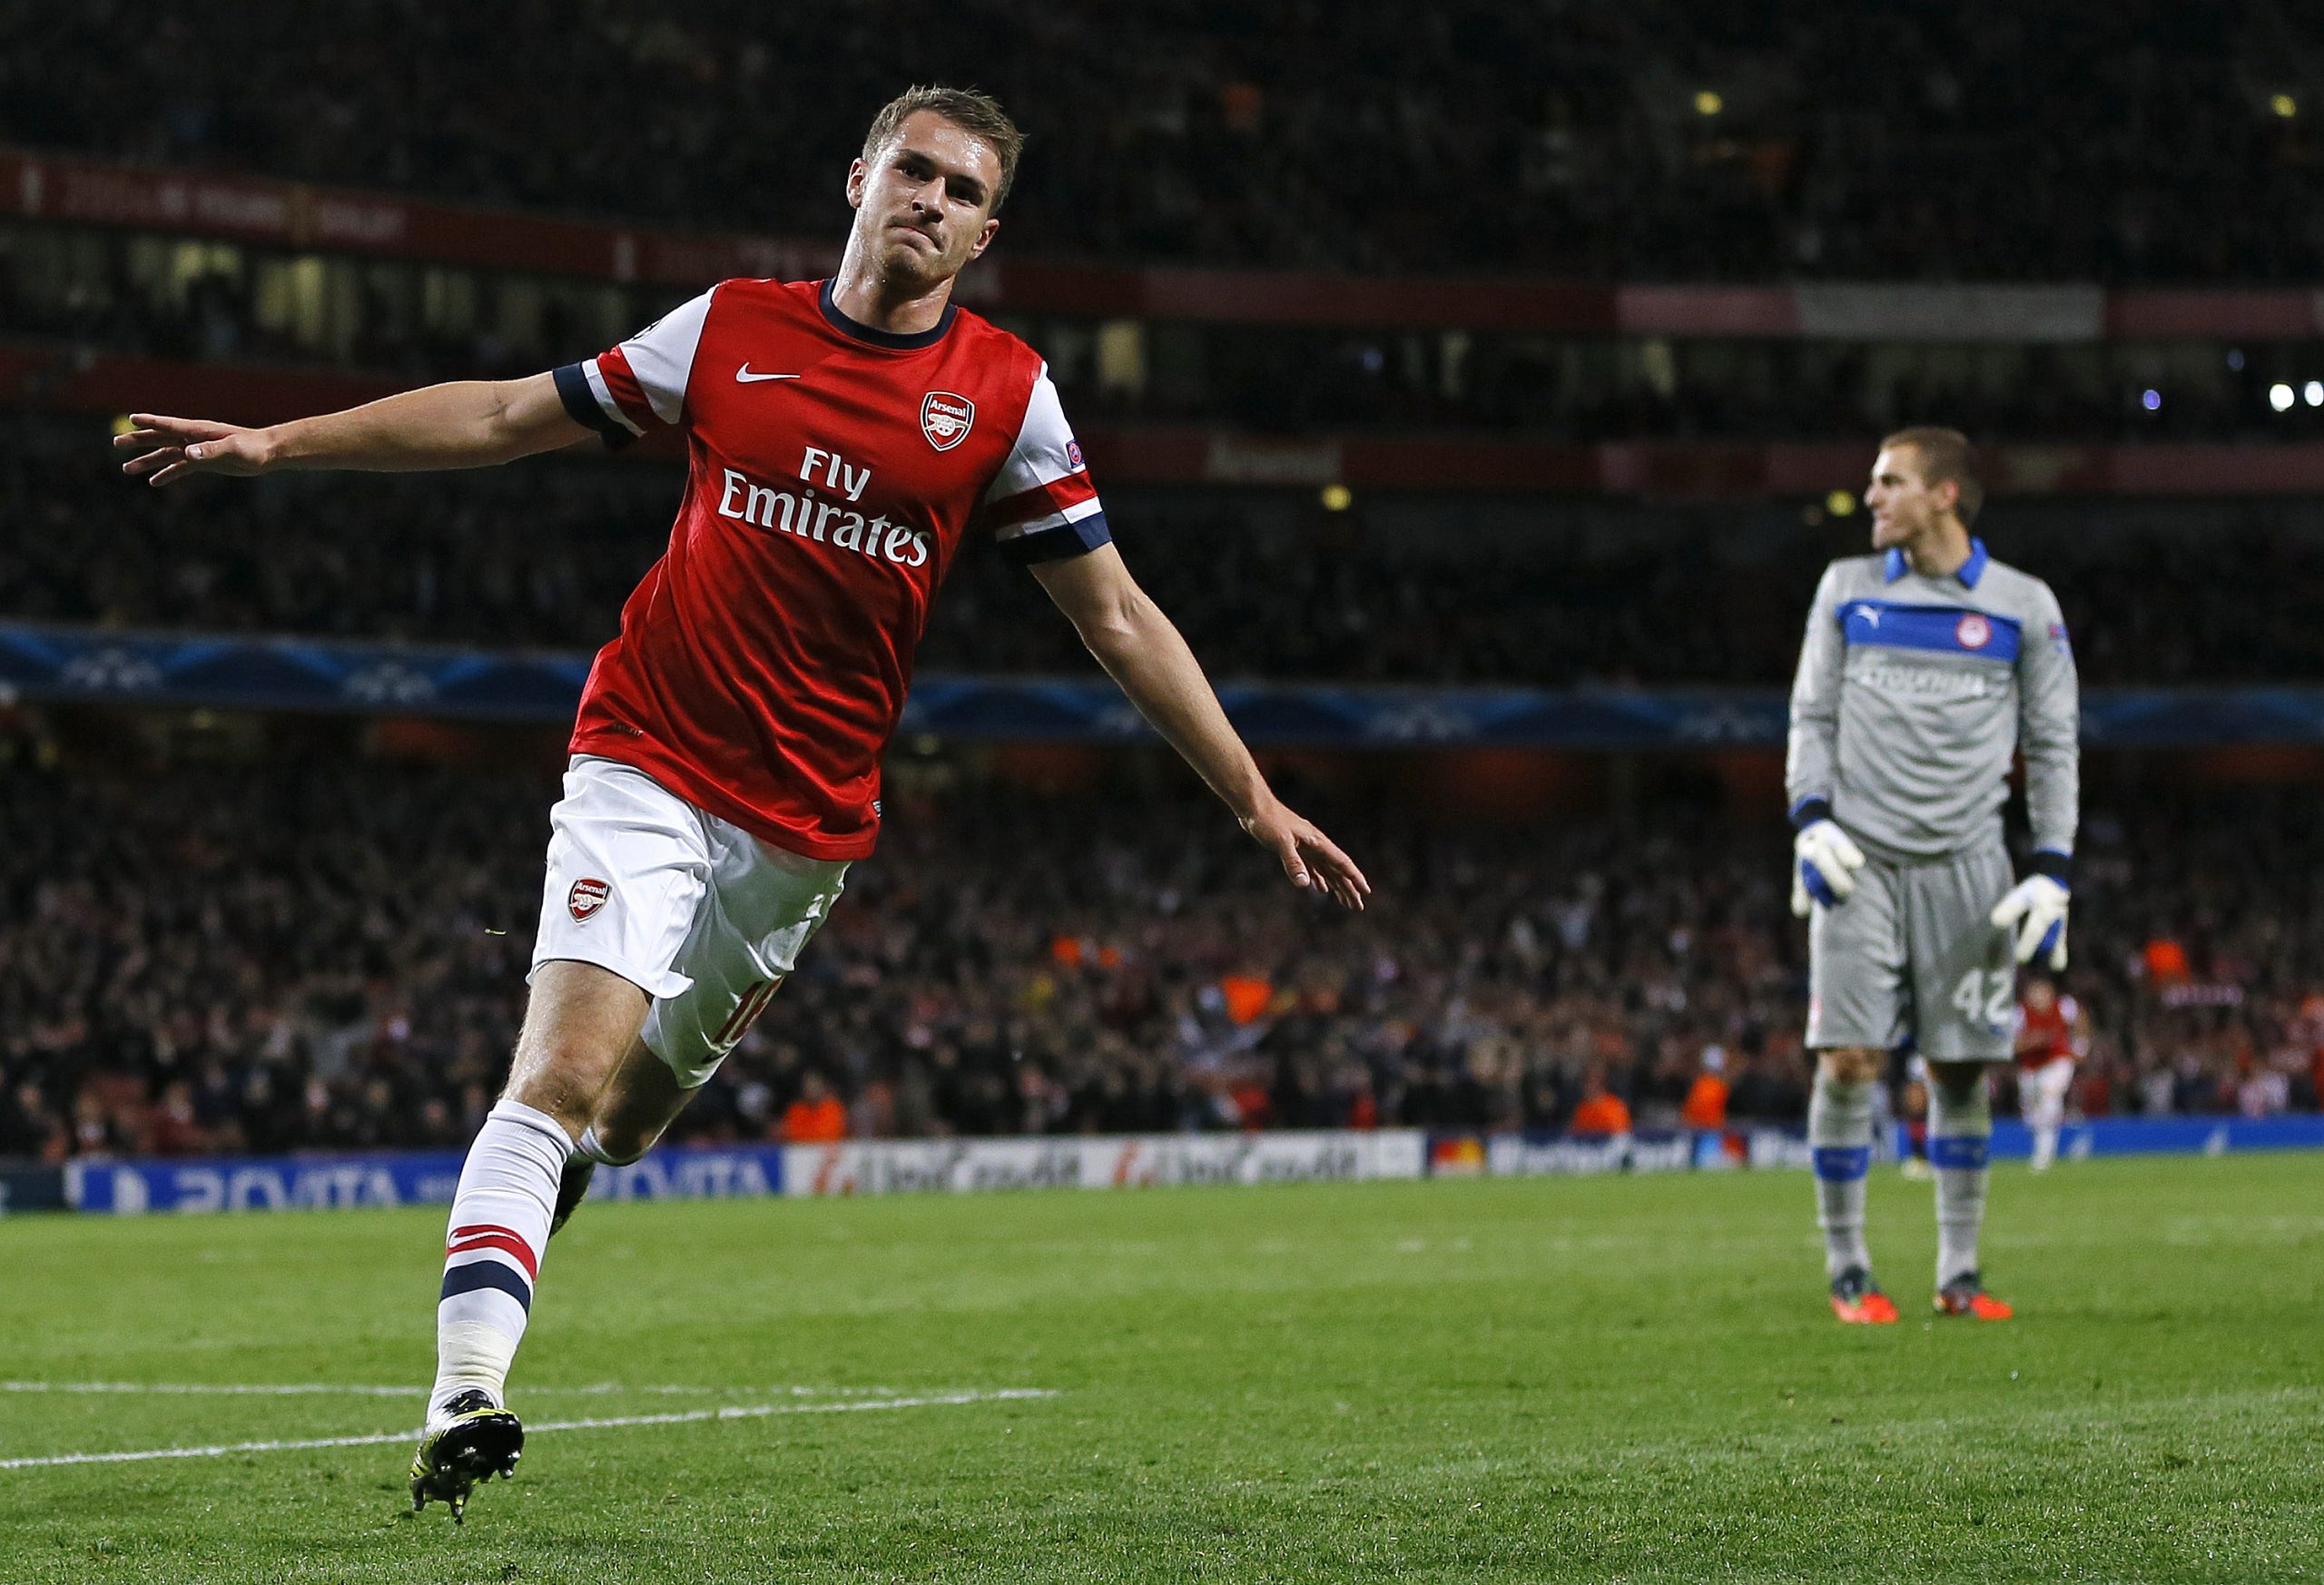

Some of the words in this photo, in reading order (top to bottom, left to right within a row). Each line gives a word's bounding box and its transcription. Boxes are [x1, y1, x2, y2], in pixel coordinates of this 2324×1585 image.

[930, 399, 967, 418] Arsenal
[799, 446, 872, 502] Fly
[718, 468, 932, 567] Emirates
[576, 881, 606, 895] Arsenal
[1954, 967, 2014, 1026] 42
